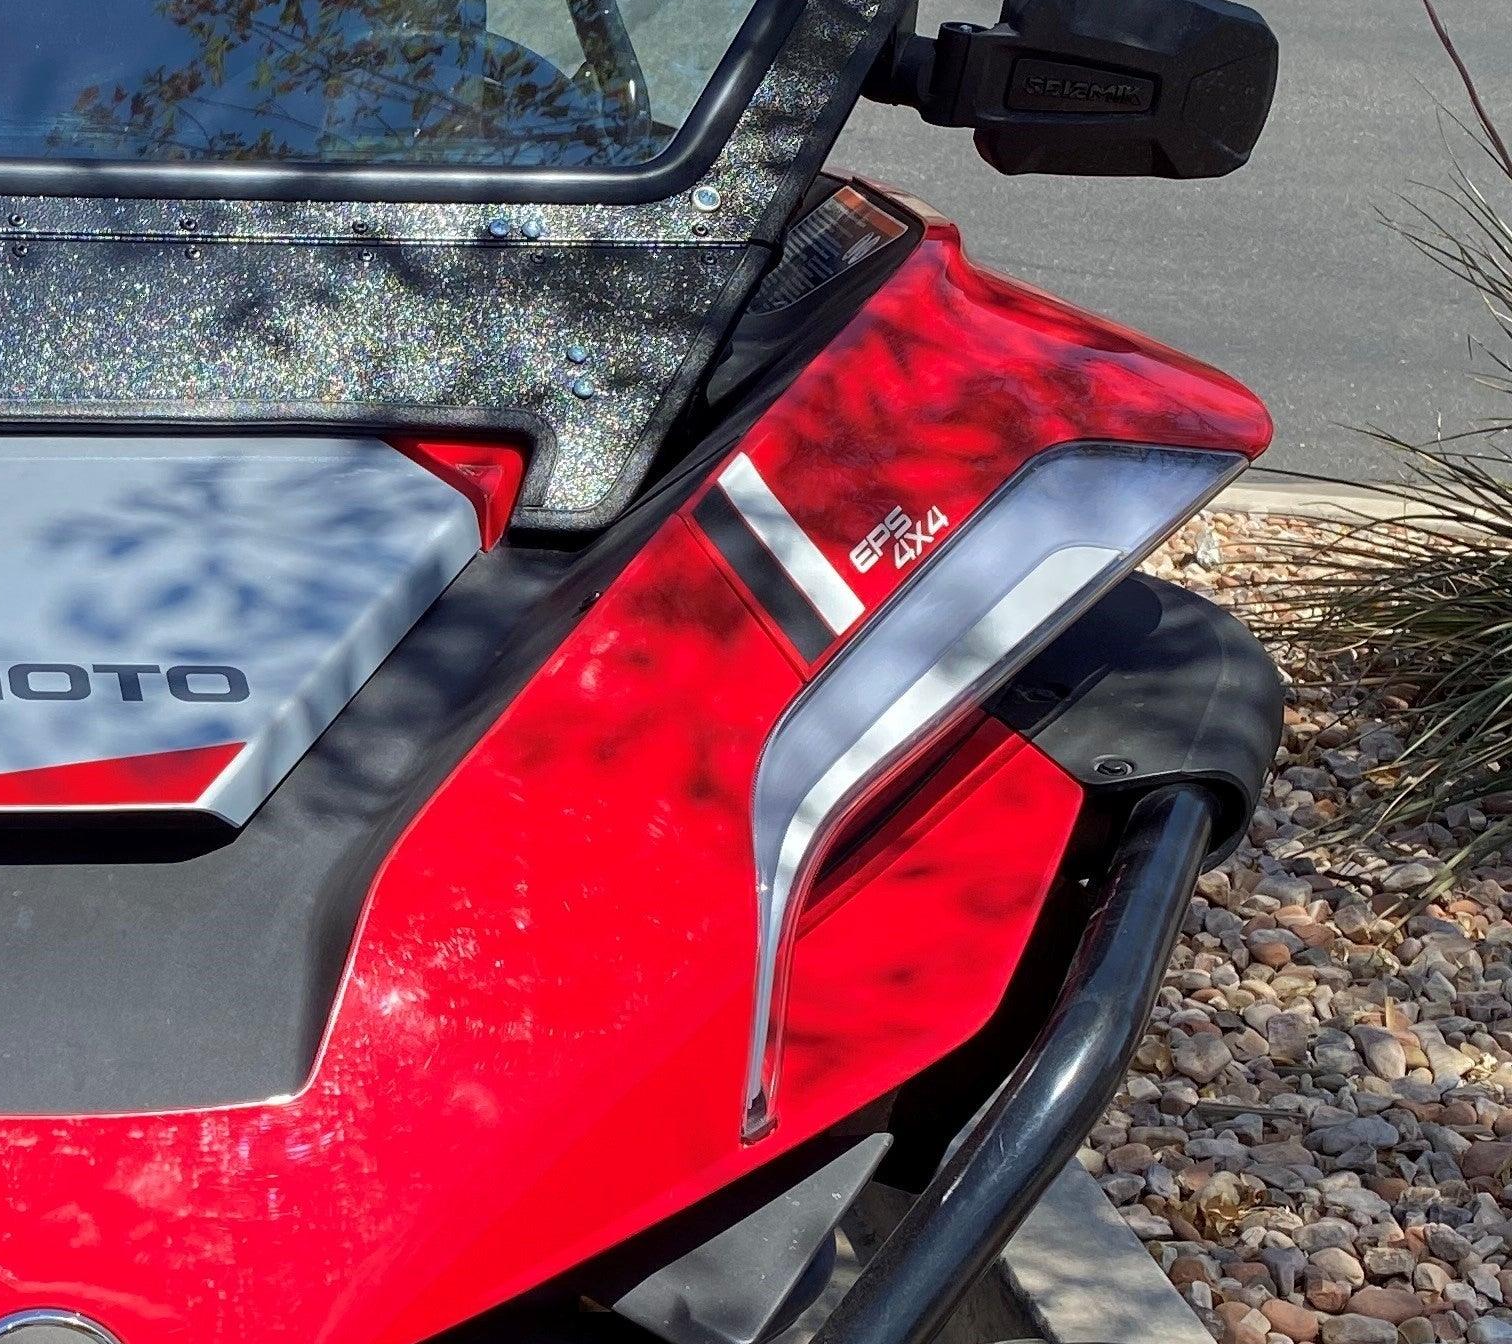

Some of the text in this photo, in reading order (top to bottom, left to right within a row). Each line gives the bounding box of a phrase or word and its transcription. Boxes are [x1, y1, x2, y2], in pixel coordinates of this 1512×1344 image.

[1025, 76, 1140, 105] SEIZMIK
[849, 505, 913, 574] EPS
[894, 505, 949, 570] 4X4
